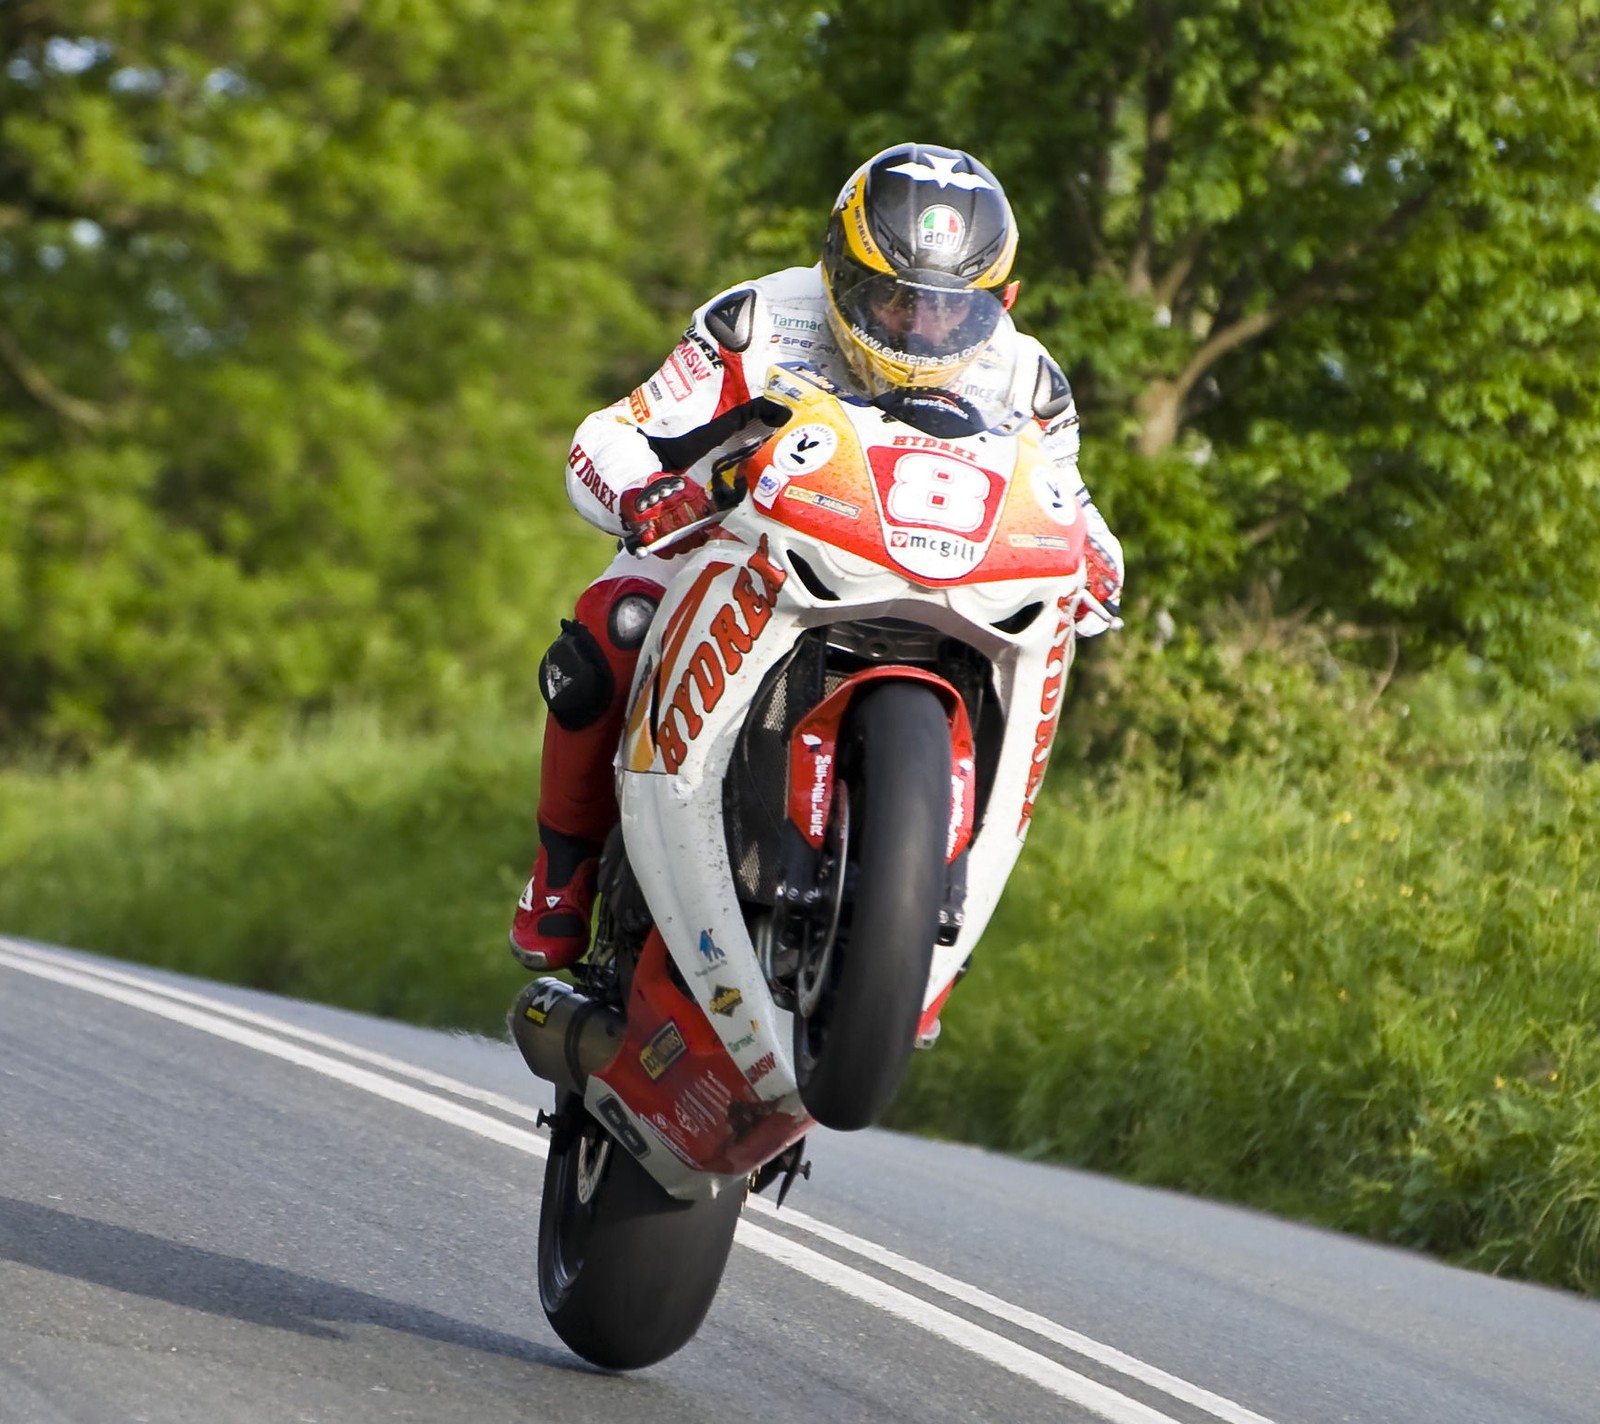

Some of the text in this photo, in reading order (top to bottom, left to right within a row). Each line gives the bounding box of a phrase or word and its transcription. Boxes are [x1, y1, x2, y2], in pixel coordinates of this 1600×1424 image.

[568, 444, 619, 514] HYDREX
[892, 435, 979, 462] HYDREX
[887, 452, 991, 533] 8
[910, 533, 976, 562] mcgill
[656, 533, 788, 775] HYDREX
[1016, 587, 1078, 837] YDRE
[810, 754, 832, 837] METZELER
